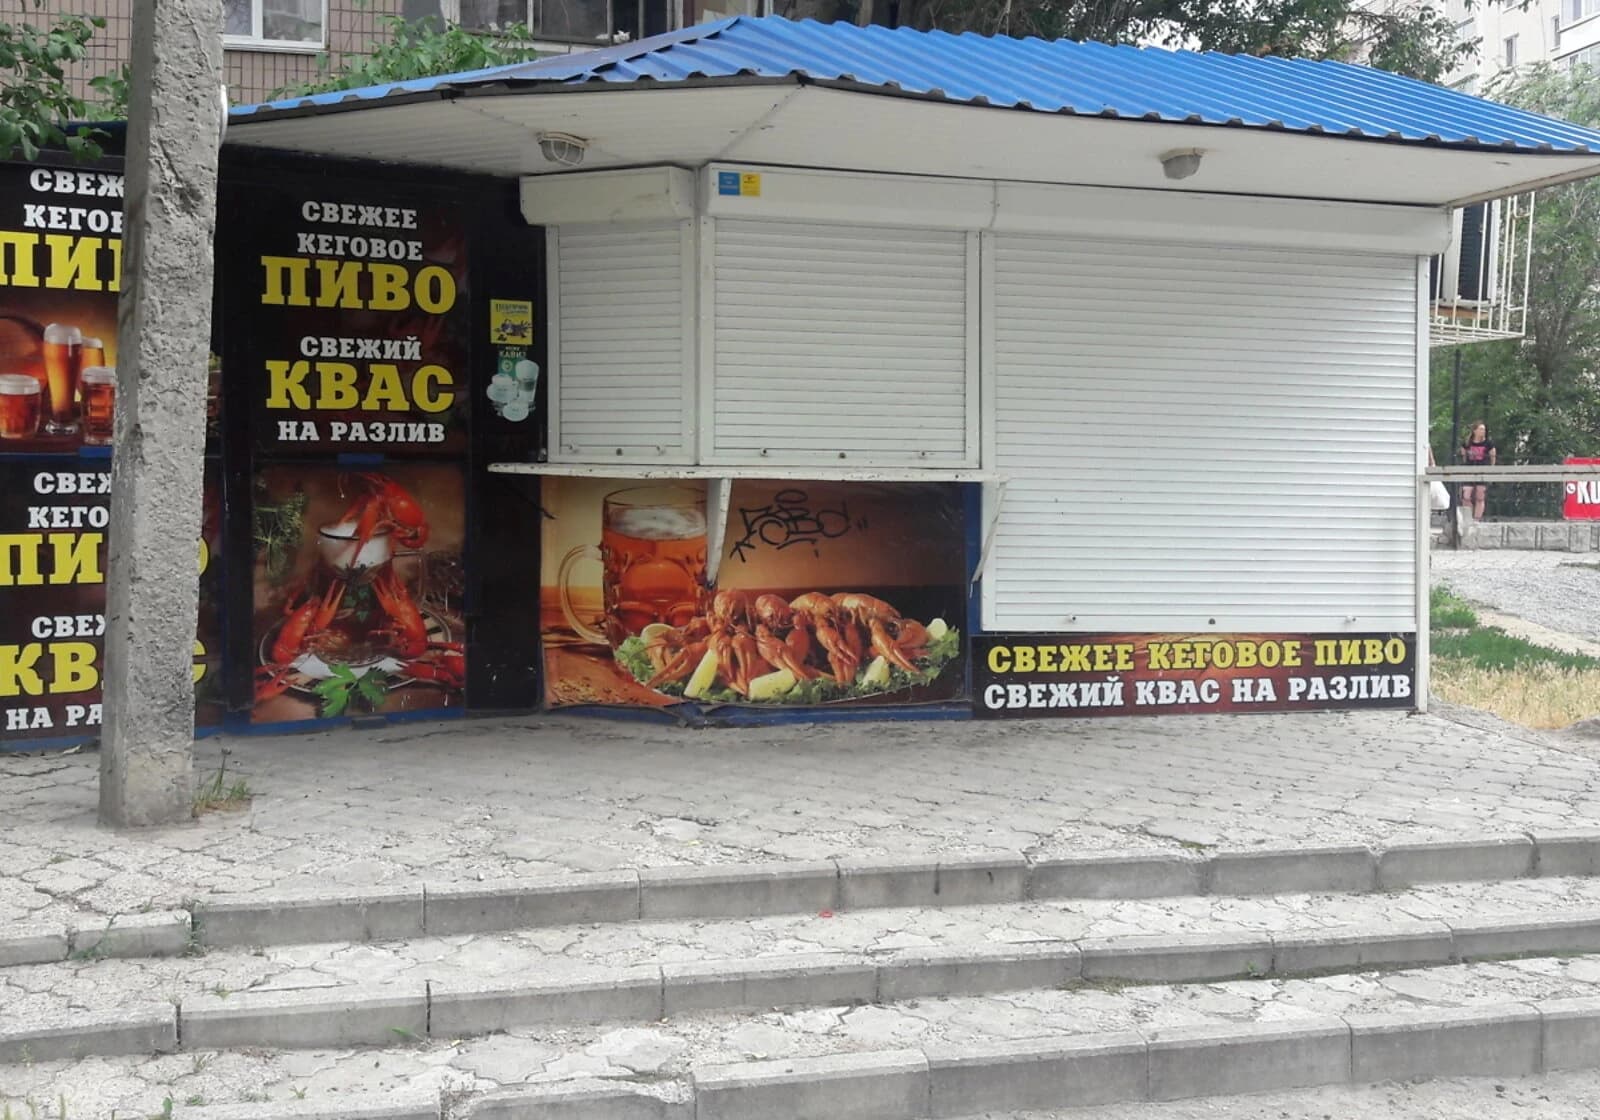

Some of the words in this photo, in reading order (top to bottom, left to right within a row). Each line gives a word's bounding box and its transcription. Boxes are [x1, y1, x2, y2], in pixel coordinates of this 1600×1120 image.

[30, 168, 125, 198] СВЕЖ
[302, 201, 417, 229] СВЕЖЕЕ
[297, 233, 423, 261] КЕГОВОЕ
[261, 255, 456, 314] ПИВО
[300, 336, 422, 360] СВЕЖИЙ
[265, 359, 455, 413] КВАС
[277, 421, 320, 441] НА
[330, 421, 445, 442] РАЗЛИВ
[28, 506, 110, 529] КЕГО
[987, 645, 1134, 673] СВЕЖЕЕ
[1148, 641, 1302, 670] КЕГОВОЕ
[1314, 638, 1406, 666] ПИВО
[983, 676, 1124, 709] СВЕЖИЙ
[1135, 680, 1221, 705] КВАС
[1232, 678, 1278, 703] НА
[1287, 675, 1411, 702] РАЗЛИВ
[5, 707, 54, 730] НА
